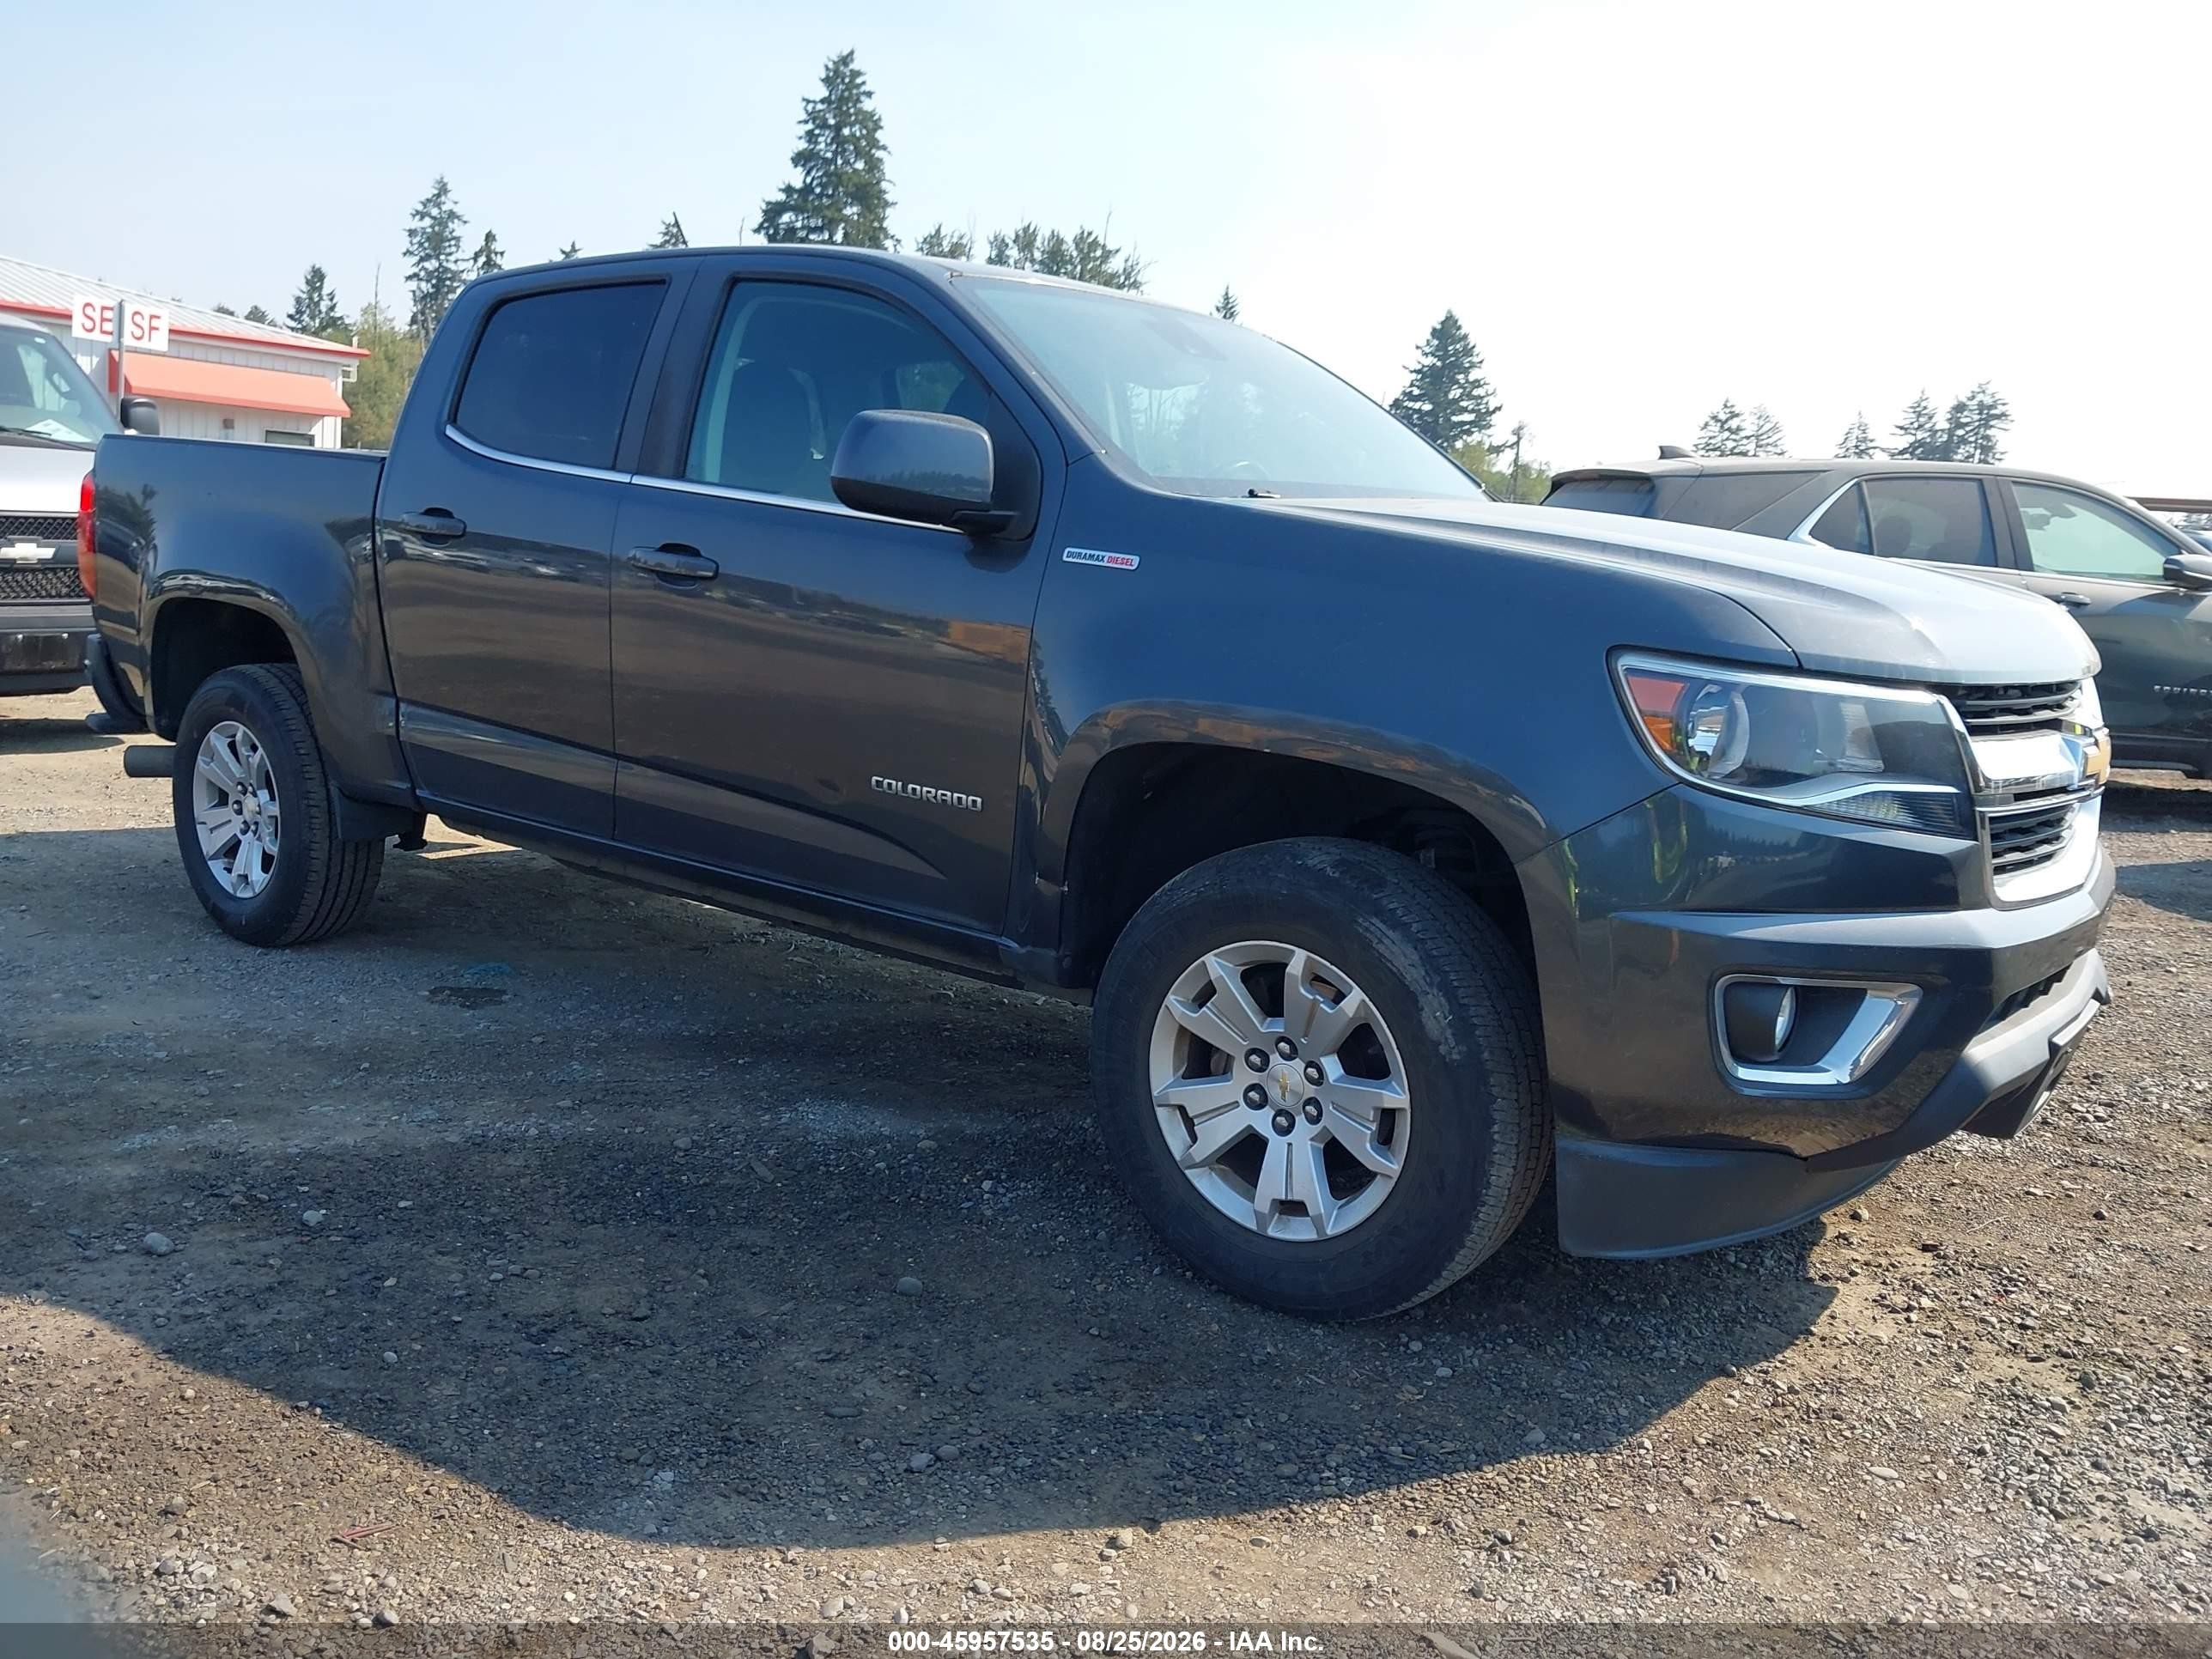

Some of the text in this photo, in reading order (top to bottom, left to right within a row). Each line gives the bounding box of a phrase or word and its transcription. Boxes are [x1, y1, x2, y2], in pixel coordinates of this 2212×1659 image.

[131, 311, 161, 343] SF
[1066, 550, 1135, 567] DURAMAX DIESEL
[871, 775, 982, 812] COLORADO
